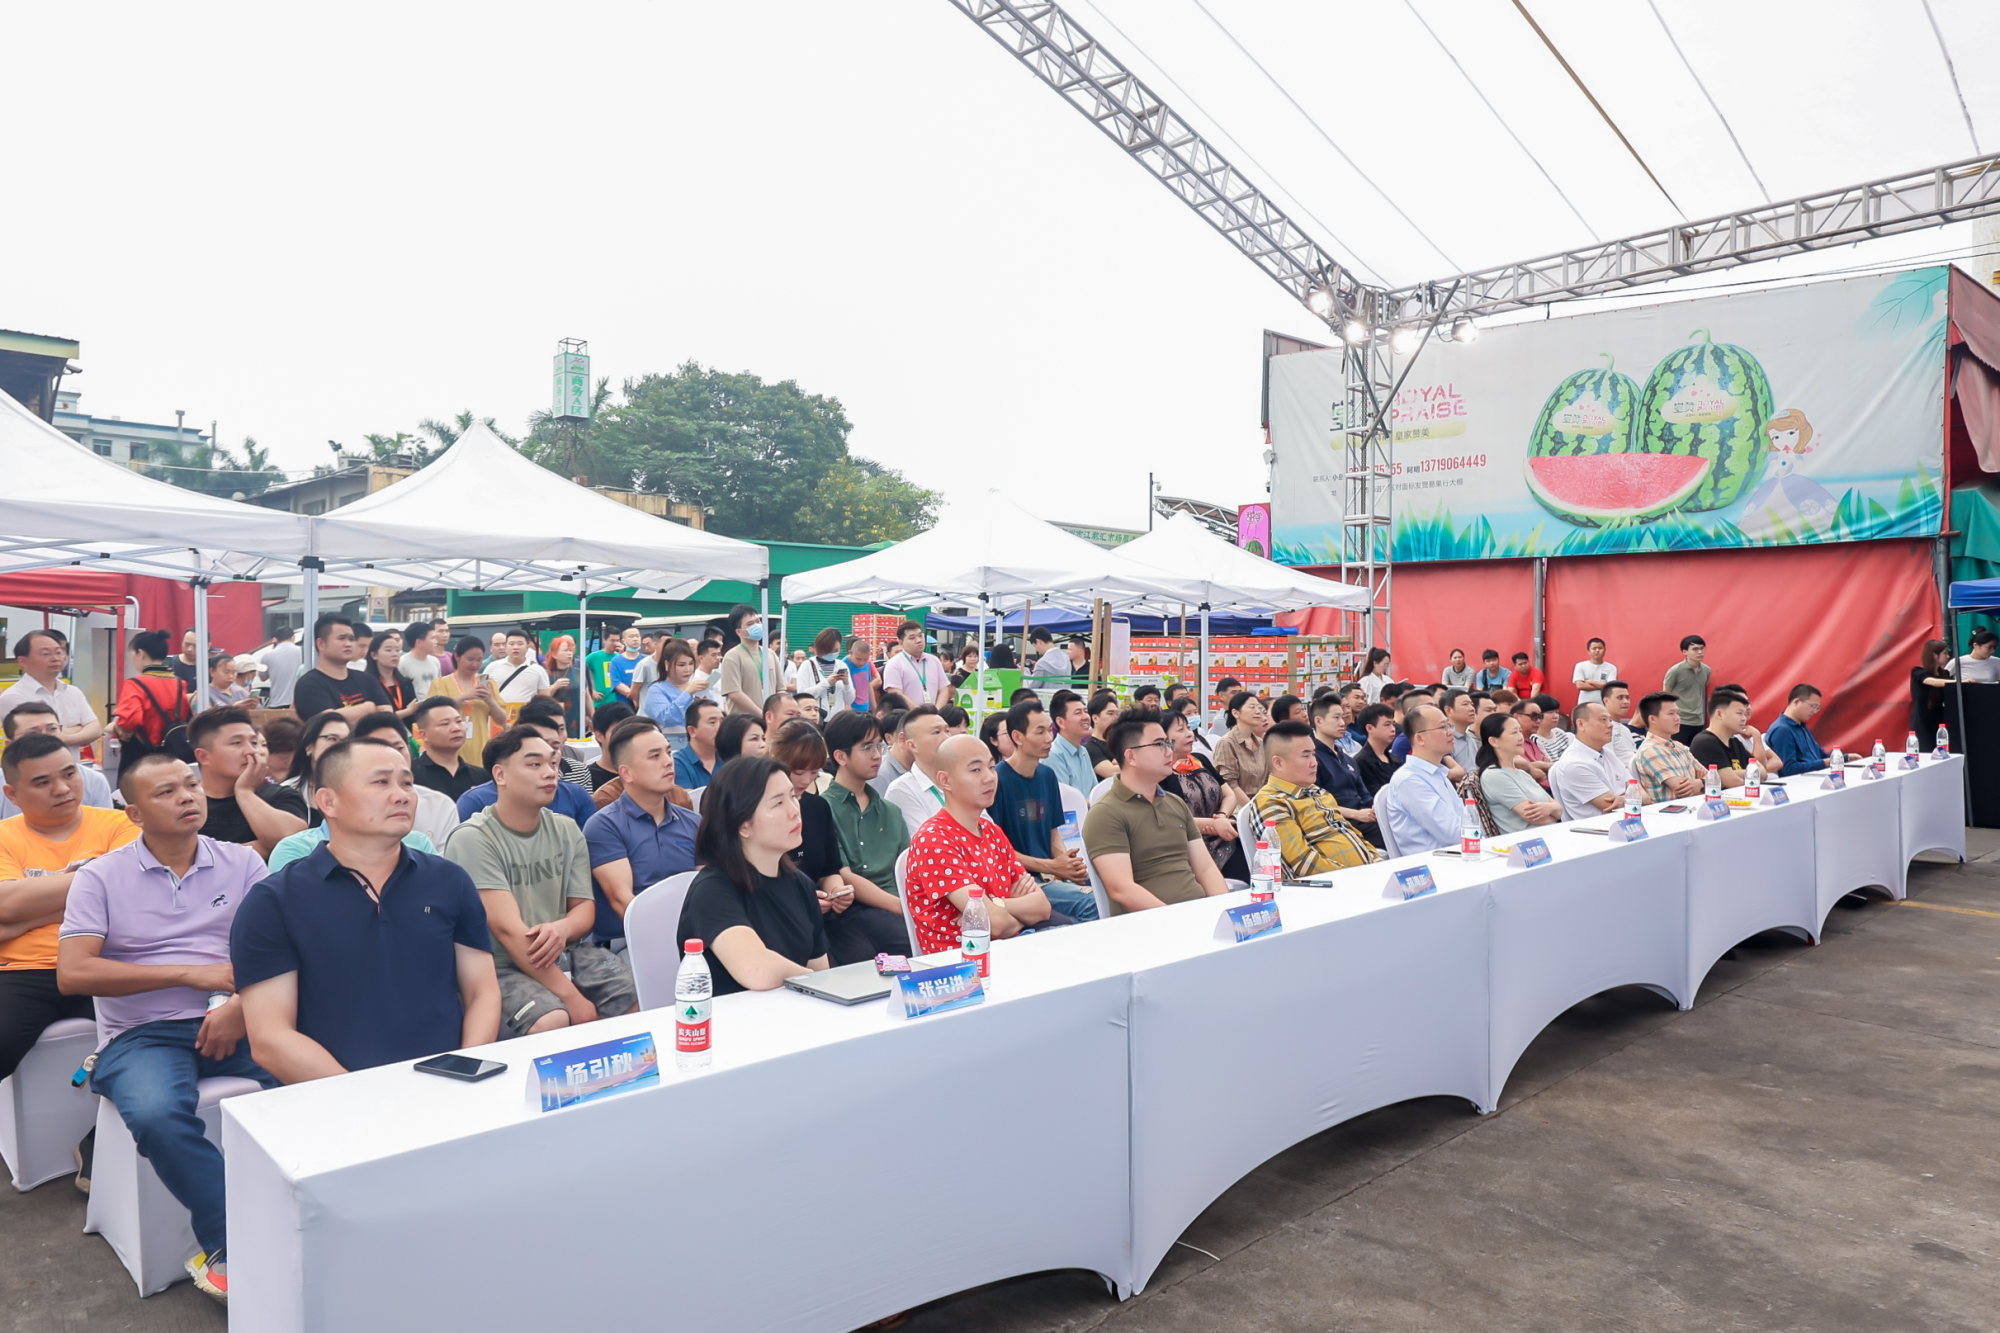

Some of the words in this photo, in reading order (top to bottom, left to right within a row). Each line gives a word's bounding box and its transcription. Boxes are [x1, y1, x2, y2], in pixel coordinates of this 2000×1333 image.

[571, 375, 584, 415] 商务A区
[1395, 427, 1430, 441] 皇家赞美
[1420, 453, 1487, 473] 13719064449
[918, 974, 966, 999] 张兴洪
[565, 1052, 633, 1087] 杨引秋
